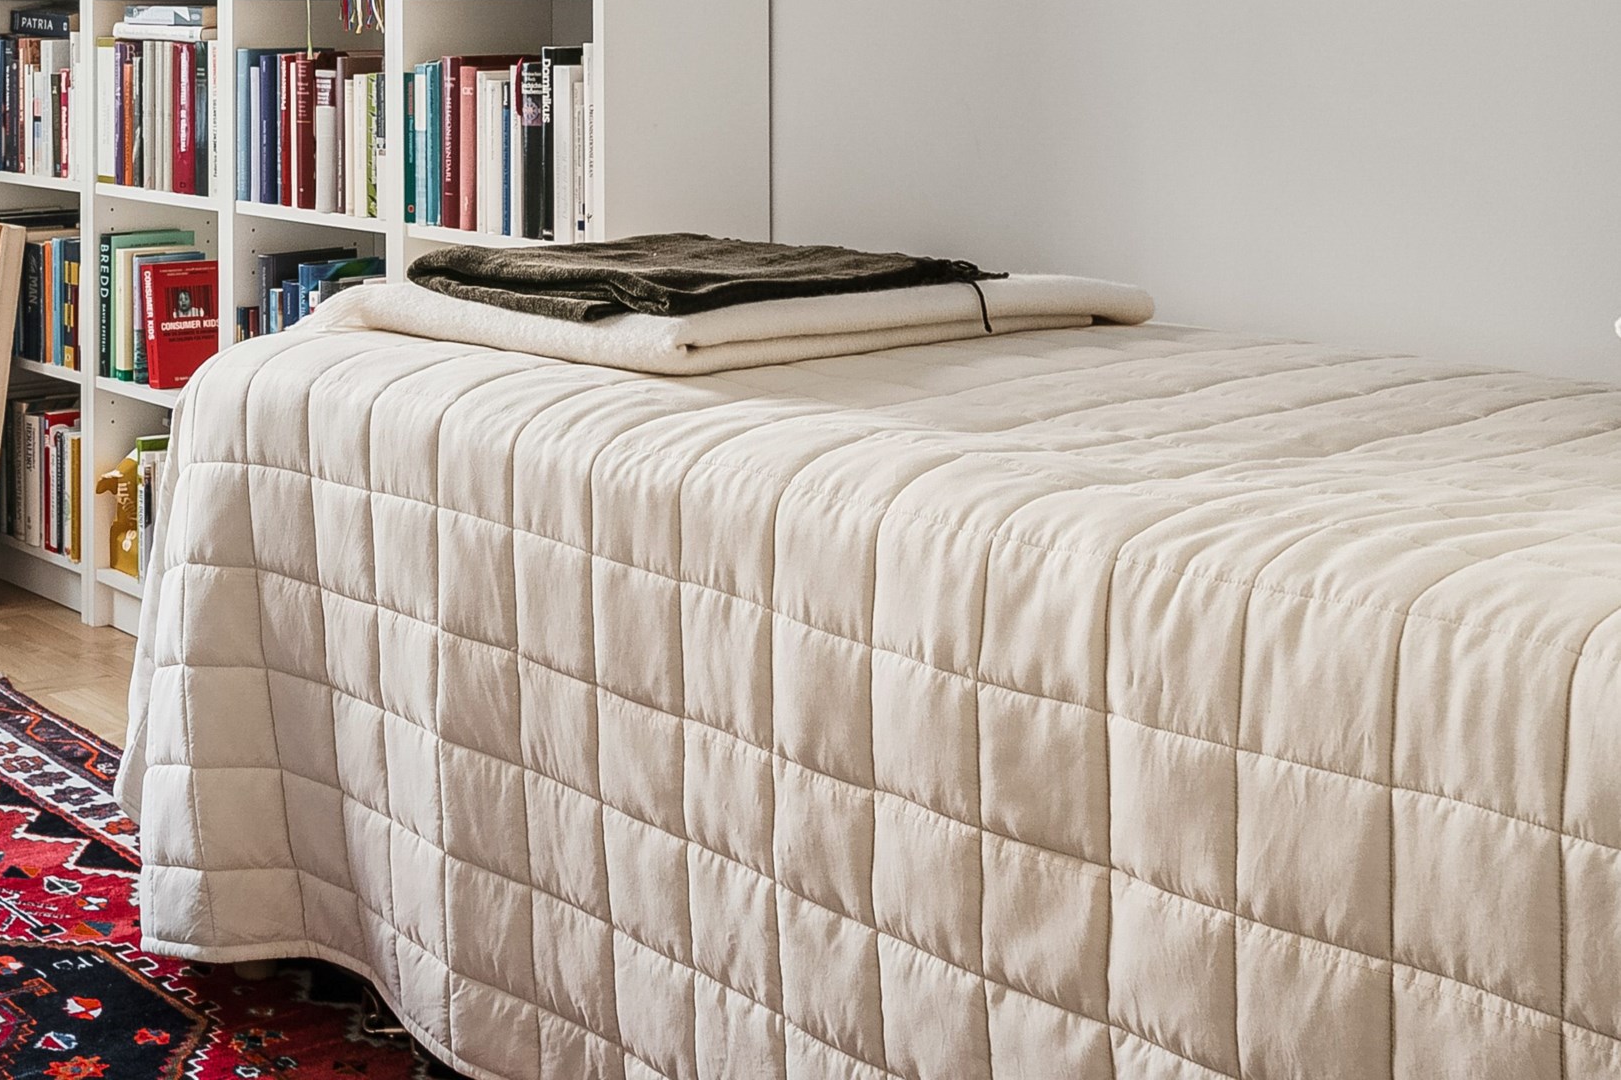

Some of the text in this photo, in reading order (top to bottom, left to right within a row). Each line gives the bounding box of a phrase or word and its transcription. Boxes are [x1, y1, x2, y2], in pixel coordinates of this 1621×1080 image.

[21, 16, 53, 31] PATRIA
[542, 58, 552, 123] Dominikus
[100, 244, 109, 298] BREDD
[144, 270, 155, 341] CONSUMER KIDS
[161, 319, 202, 331] CONSUMER
